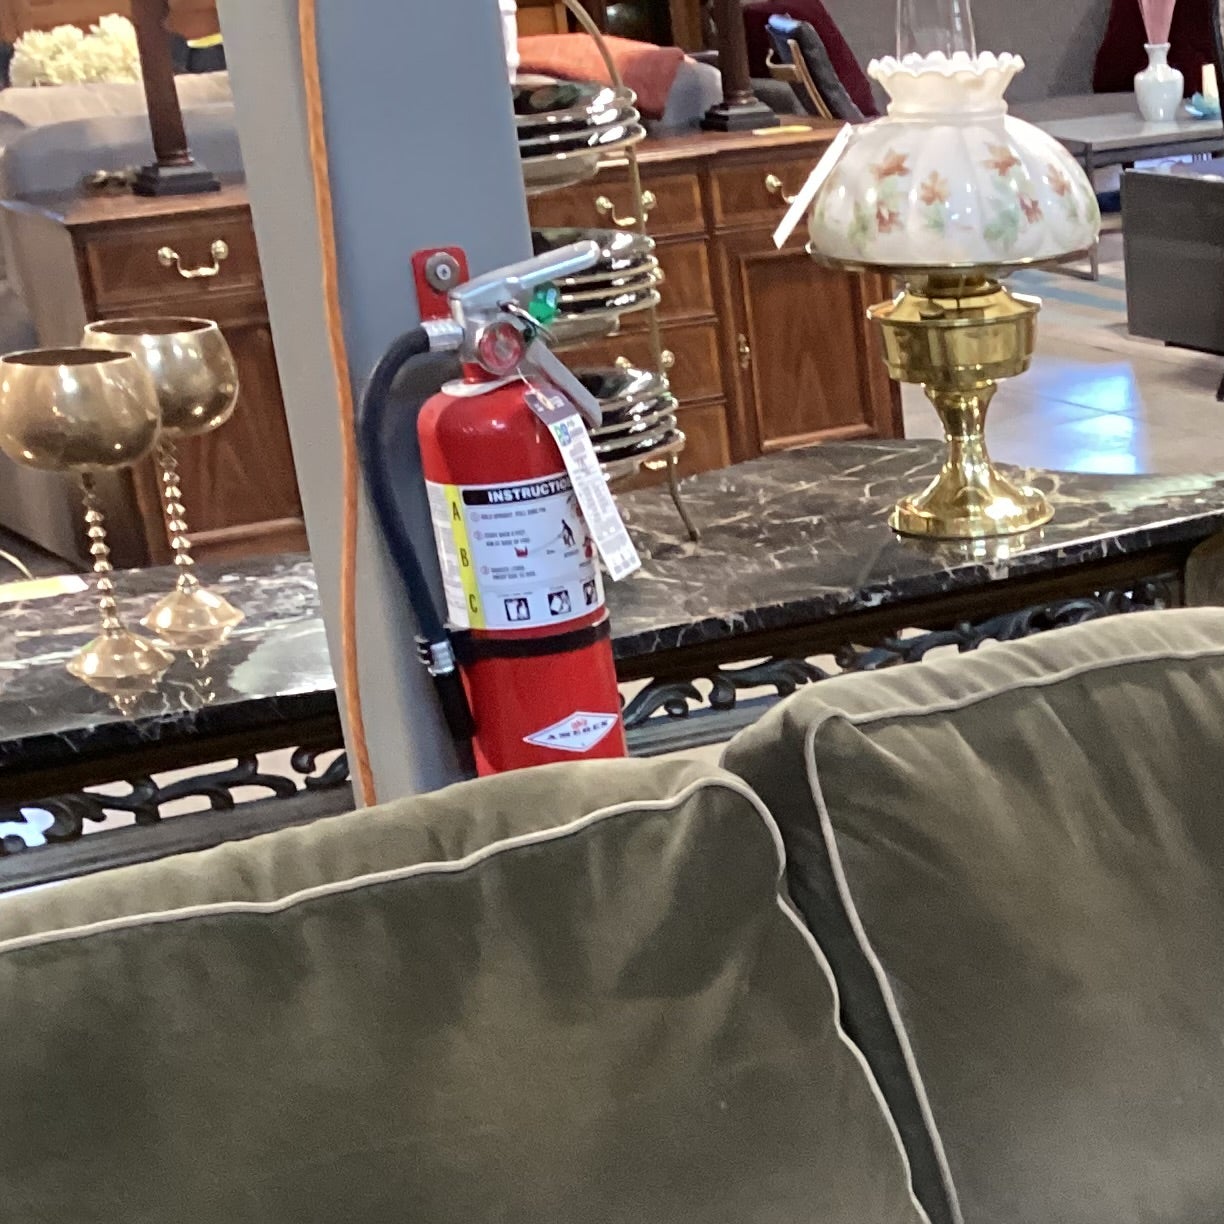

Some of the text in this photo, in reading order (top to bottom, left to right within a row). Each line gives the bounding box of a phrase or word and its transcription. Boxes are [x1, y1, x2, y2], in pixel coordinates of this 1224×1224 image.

[487, 478, 573, 504] INSTRUCTIO
[452, 501, 461, 521] A
[460, 548, 469, 567] B
[468, 594, 478, 613] C
